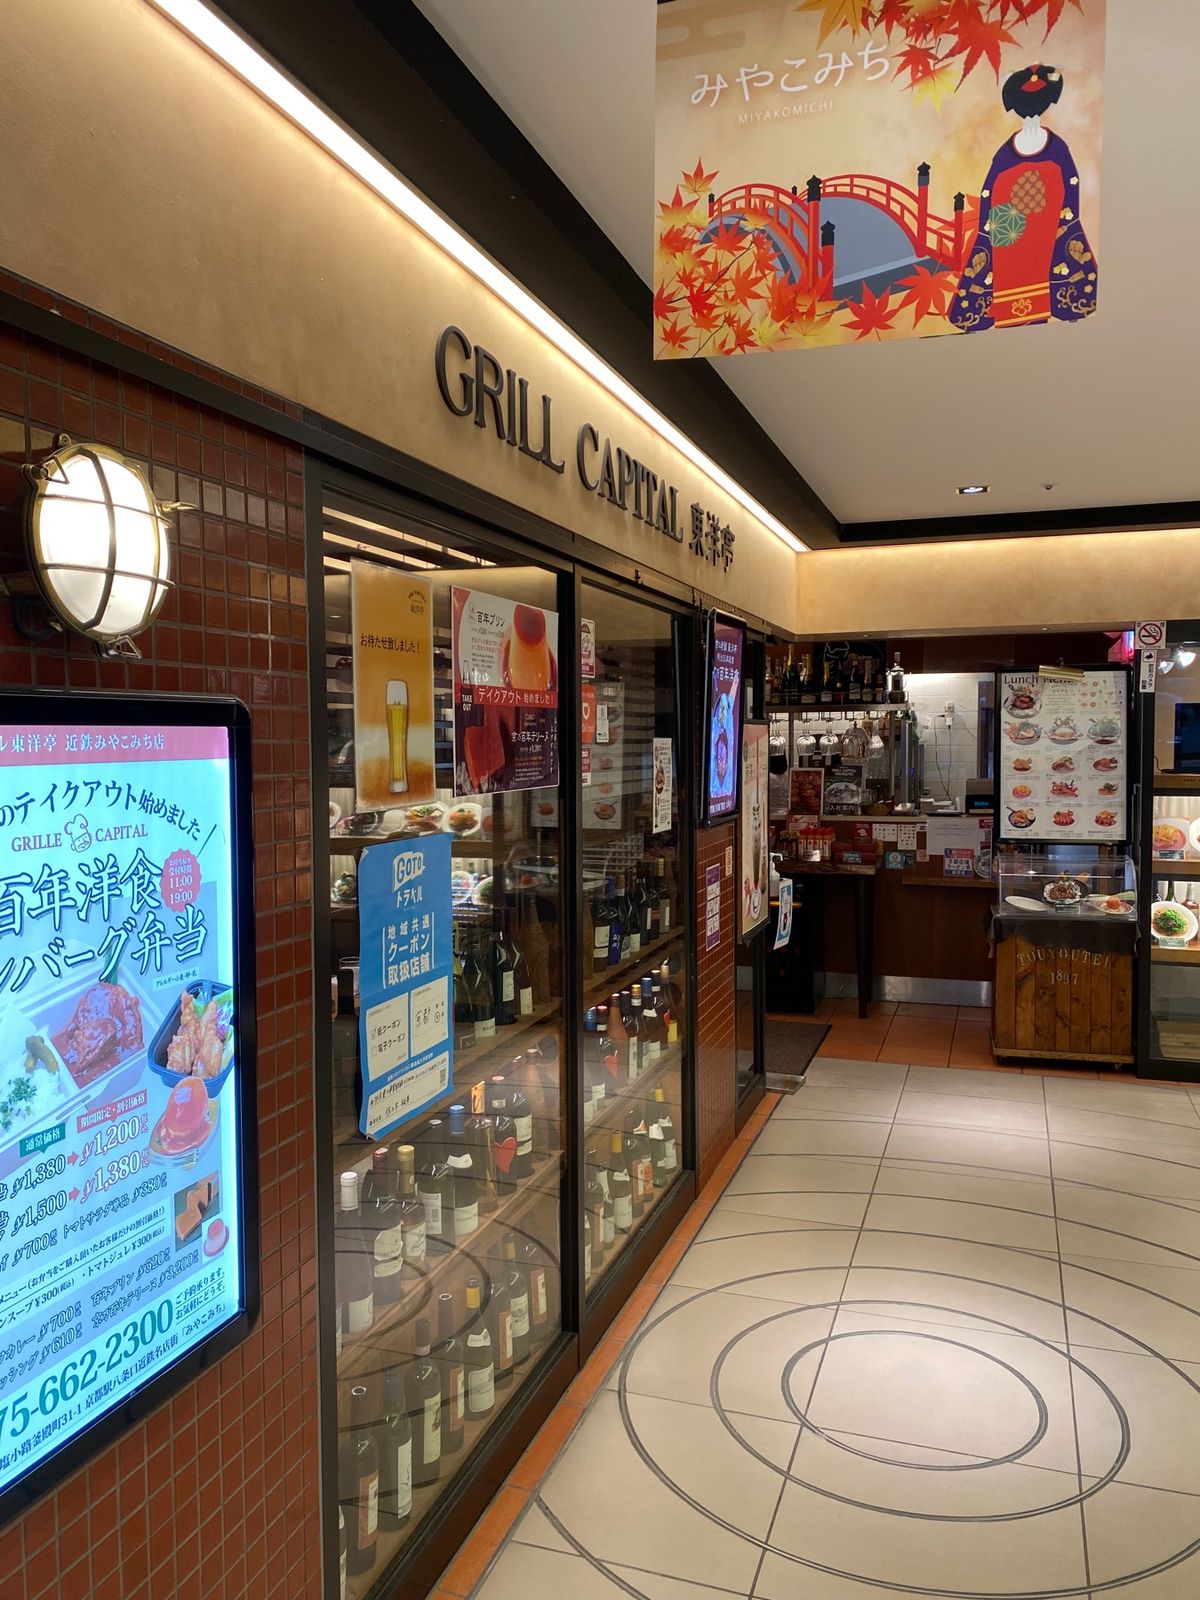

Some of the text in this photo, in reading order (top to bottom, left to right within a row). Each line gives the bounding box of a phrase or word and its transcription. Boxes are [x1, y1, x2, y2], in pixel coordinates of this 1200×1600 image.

[691, 39, 890, 108] みやこみち
[738, 101, 834, 125] MIYAKOMICHI
[435, 325, 736, 572] GRILL CAPITAL 東洋亭
[1004, 675, 1039, 684] Lunch
[478, 688, 521, 704] テイクアウト
[462, 703, 472, 712] OUT
[66, 733, 165, 751] 近鉄みやこみち店
[11, 824, 148, 852] GRILLE CAPITAL
[170, 875, 192, 889] 11:00
[170, 890, 193, 904] 19:00
[396, 887, 423, 908] トラベル
[388, 933, 430, 961] クーポン
[388, 960, 431, 986] 取扱店舗
[1050, 970, 1079, 985] 1897
